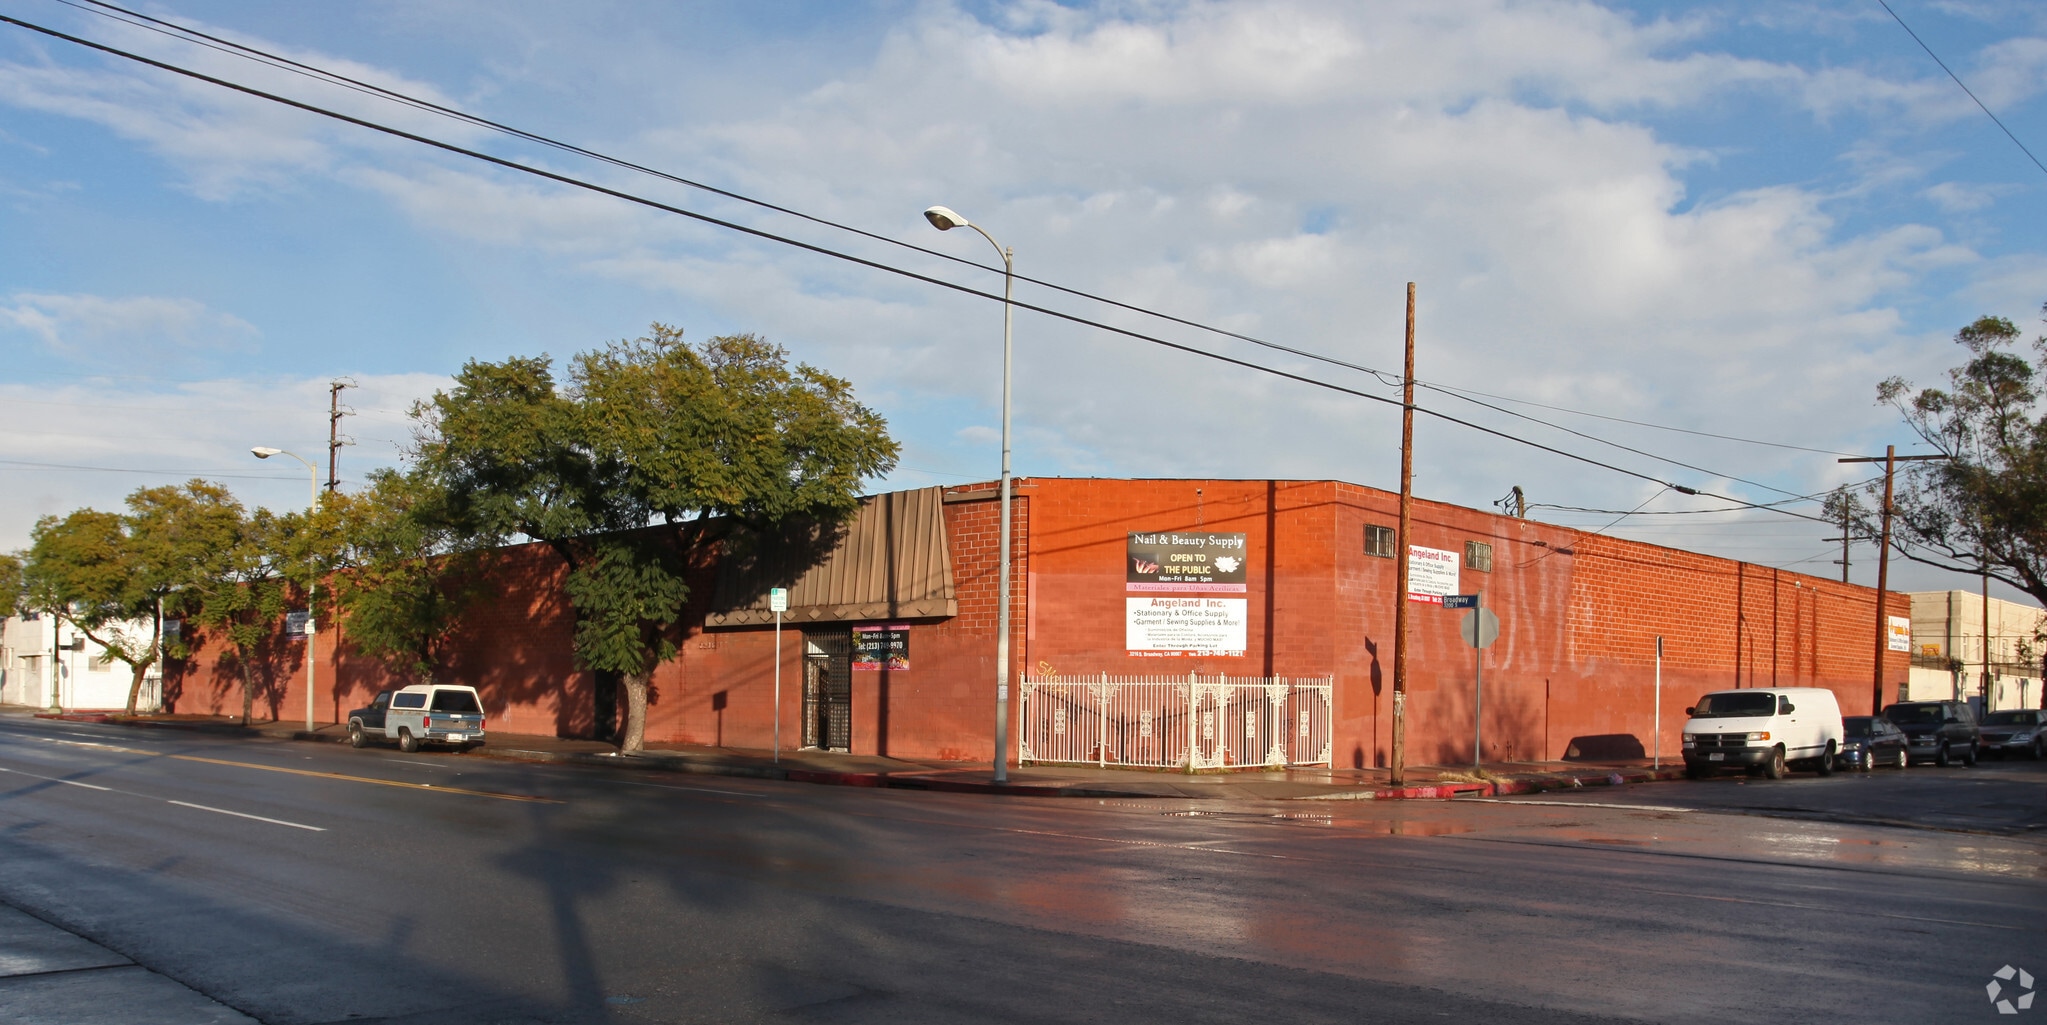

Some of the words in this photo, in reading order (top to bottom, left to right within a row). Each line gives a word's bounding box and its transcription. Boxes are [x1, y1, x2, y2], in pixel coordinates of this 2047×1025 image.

[1134, 535, 1156, 544] Nail
[1159, 535, 1168, 544] &
[1172, 535, 1206, 548] Beauty
[1209, 536, 1243, 548] Supply
[1170, 554, 1193, 562] OPEN
[1195, 554, 1206, 562] TO
[1409, 547, 1439, 560] Angeland
[1441, 552, 1453, 562] Inc.
[1164, 565, 1181, 574] THE
[1182, 565, 1211, 574] PUBLIC
[1151, 598, 1200, 609] Angeland
[1206, 599, 1226, 608] Inc.
[867, 642, 880, 650] (213)
